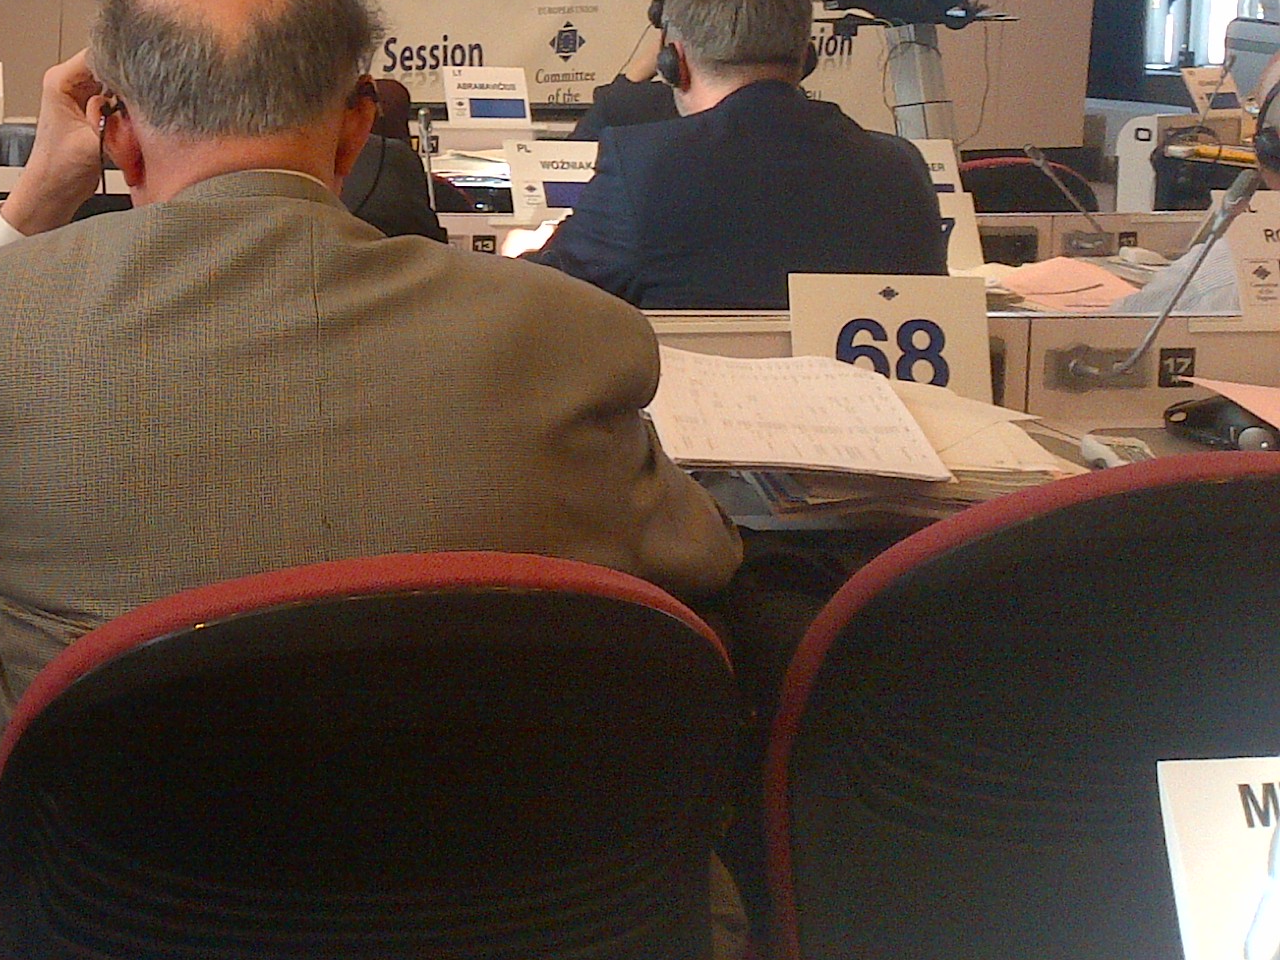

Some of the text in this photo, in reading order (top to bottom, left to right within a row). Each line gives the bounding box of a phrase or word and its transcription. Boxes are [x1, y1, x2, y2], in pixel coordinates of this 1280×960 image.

[382, 34, 484, 73] Session
[535, 67, 597, 85] Committee
[547, 87, 581, 104] of the
[517, 143, 532, 153] PL
[475, 239, 495, 252] 13
[834, 318, 951, 389] 68
